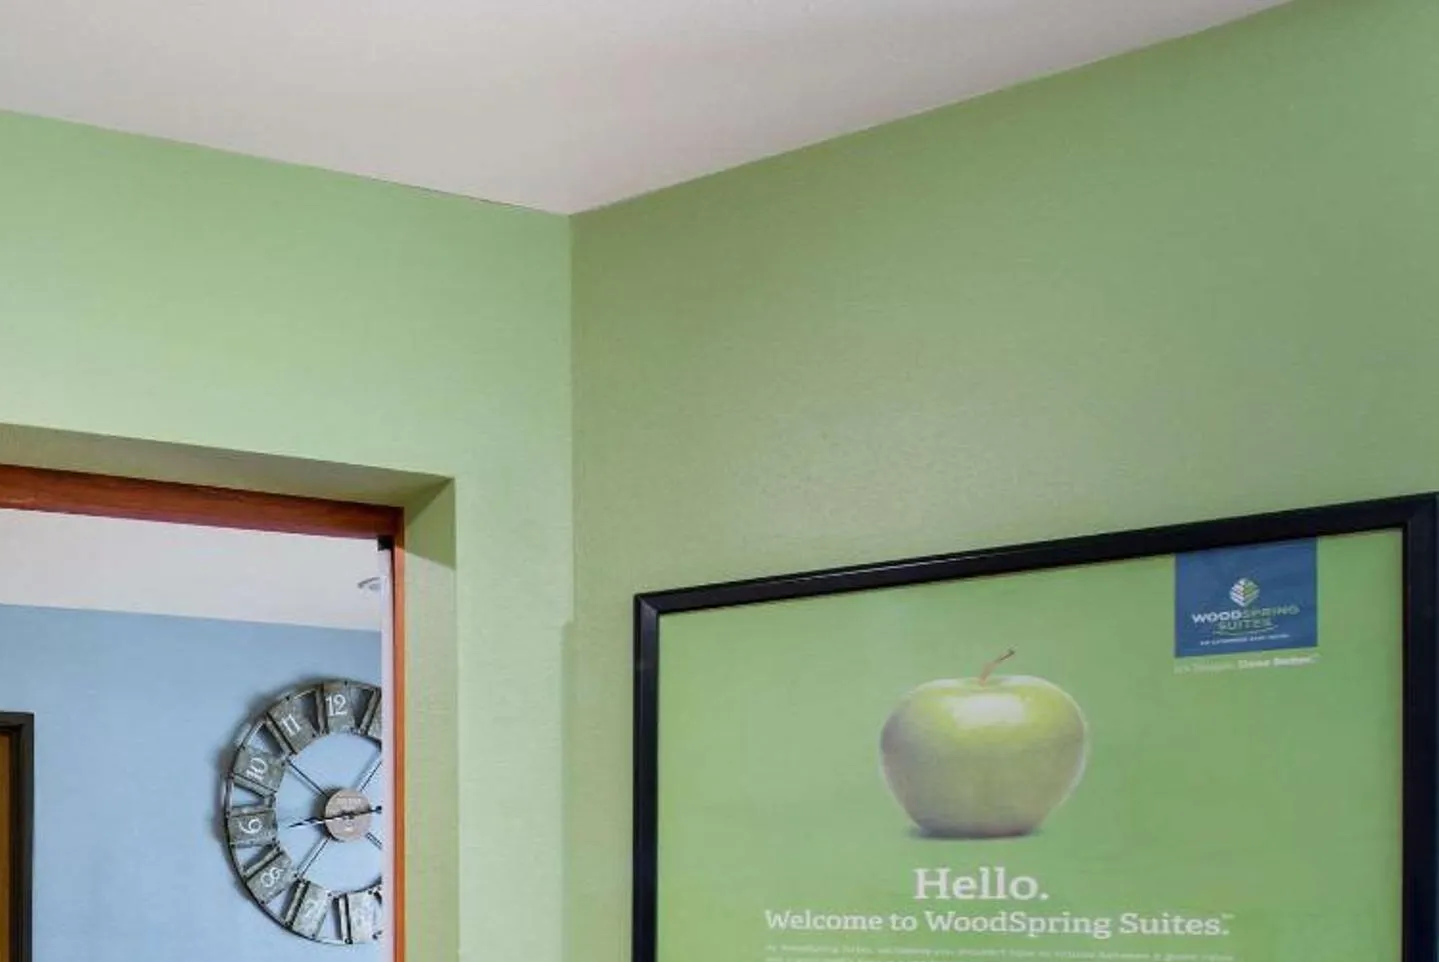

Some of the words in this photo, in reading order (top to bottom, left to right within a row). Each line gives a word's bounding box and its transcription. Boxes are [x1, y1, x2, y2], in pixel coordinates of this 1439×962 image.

[1191, 605, 1300, 624] WOODSPRING
[325, 694, 348, 717] 12
[281, 713, 301, 737] 11
[245, 757, 269, 781] 10
[913, 866, 1050, 901] Hello.
[764, 909, 884, 931] Welcome
[890, 912, 918, 932] to
[924, 910, 1112, 940] WoodSpring
